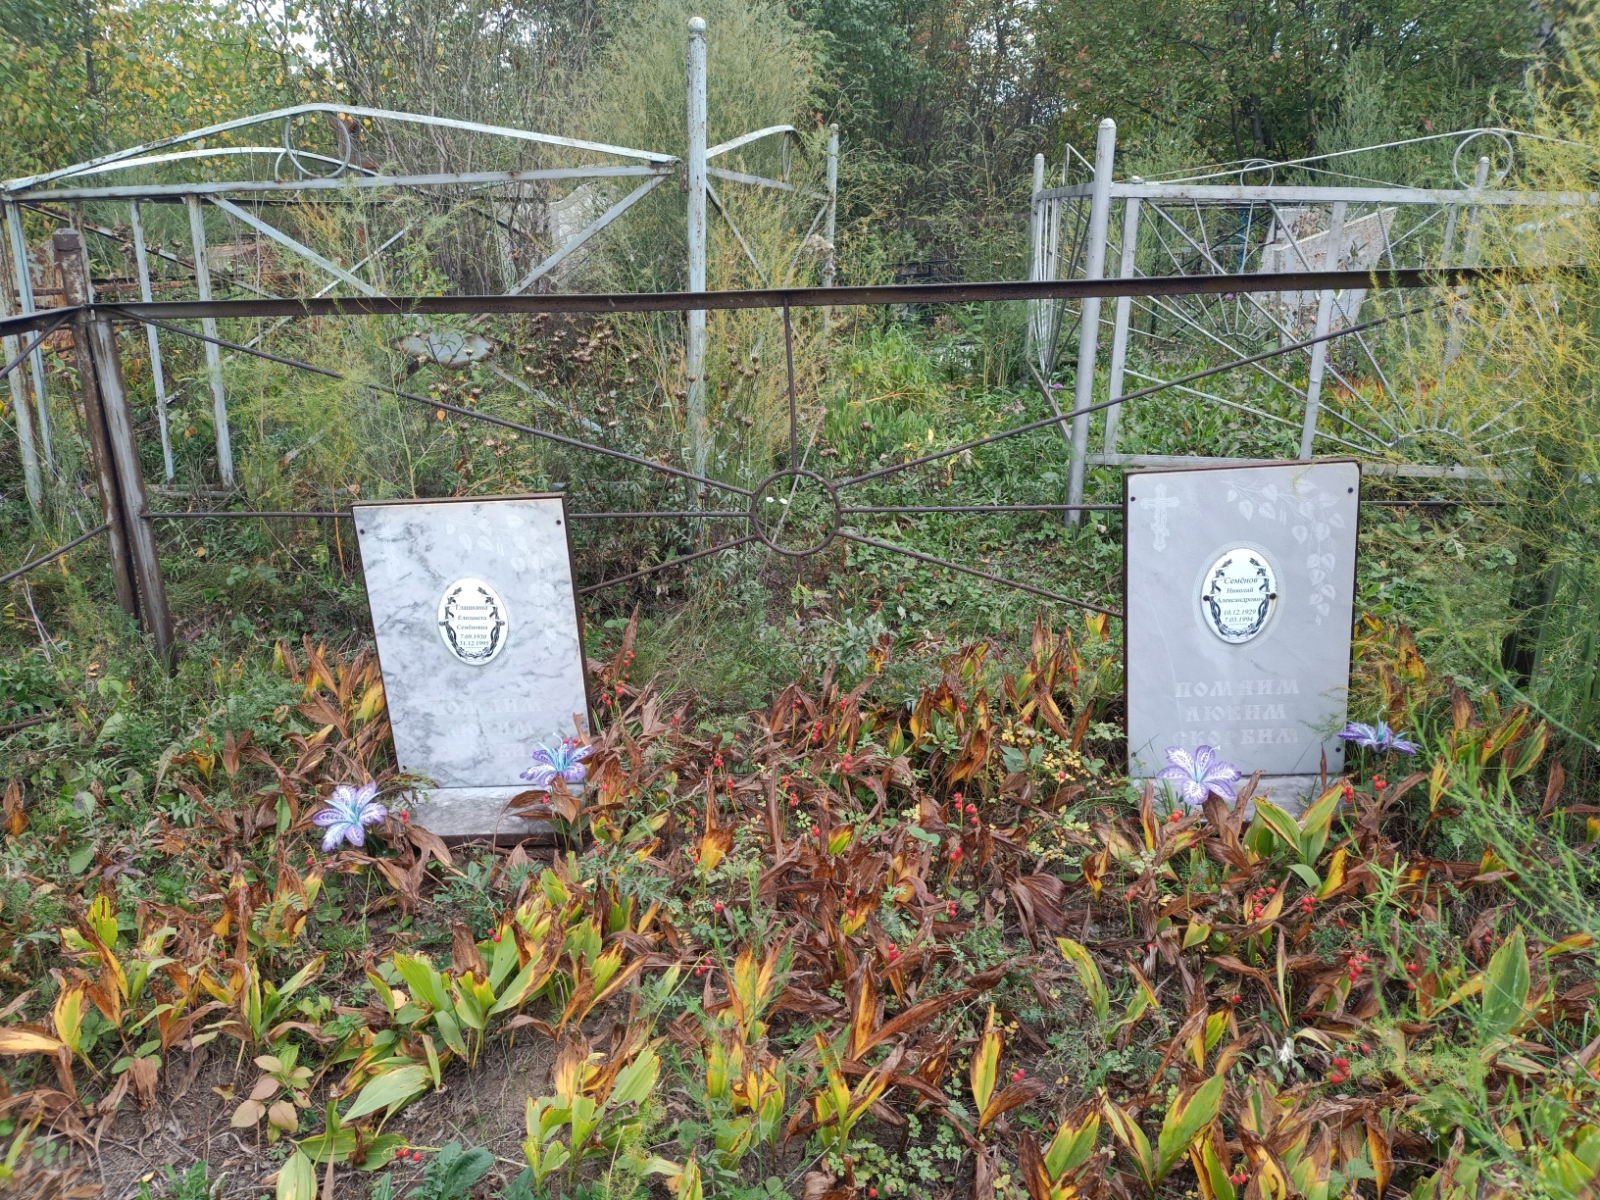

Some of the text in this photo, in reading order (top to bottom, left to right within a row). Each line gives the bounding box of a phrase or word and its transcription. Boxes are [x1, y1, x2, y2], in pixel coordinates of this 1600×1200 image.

[1174, 678, 1301, 698] ПОМНИМ
[1186, 704, 1287, 722] ЛЮБИМ
[1172, 727, 1301, 746] СКОРБИМ
